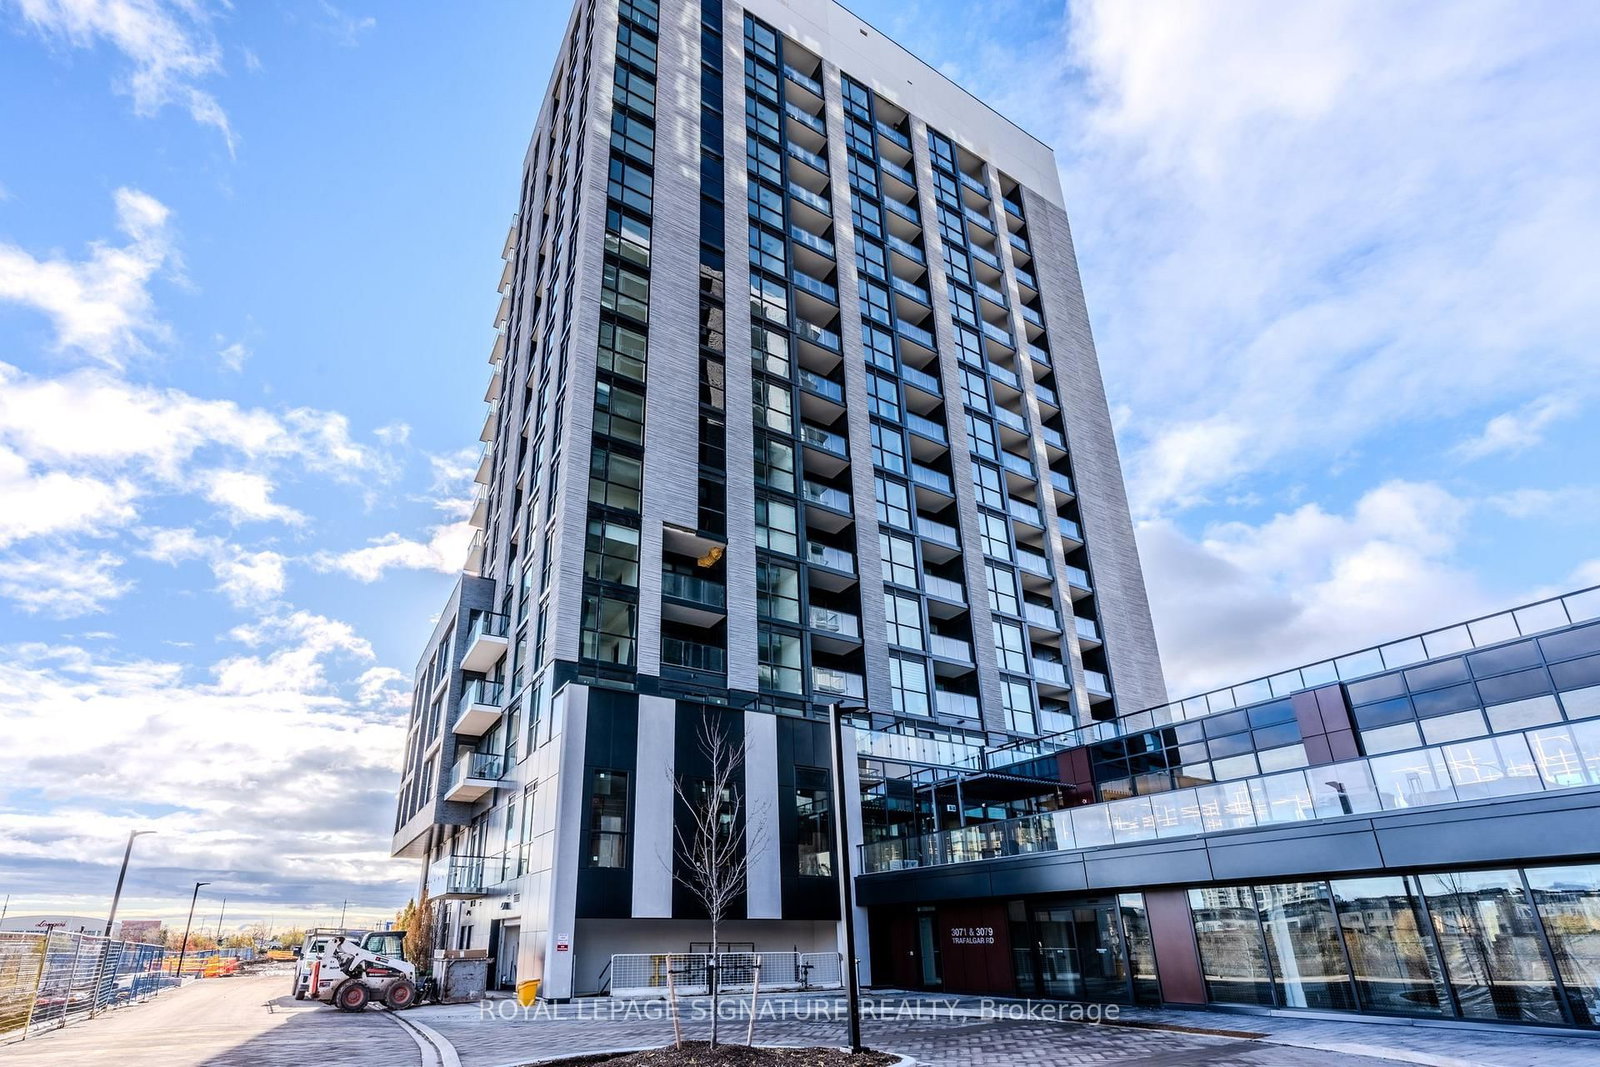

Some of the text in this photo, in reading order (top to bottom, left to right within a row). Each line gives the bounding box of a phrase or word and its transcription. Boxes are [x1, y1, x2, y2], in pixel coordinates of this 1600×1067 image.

[951, 927, 993, 936] 3071 & 3079
